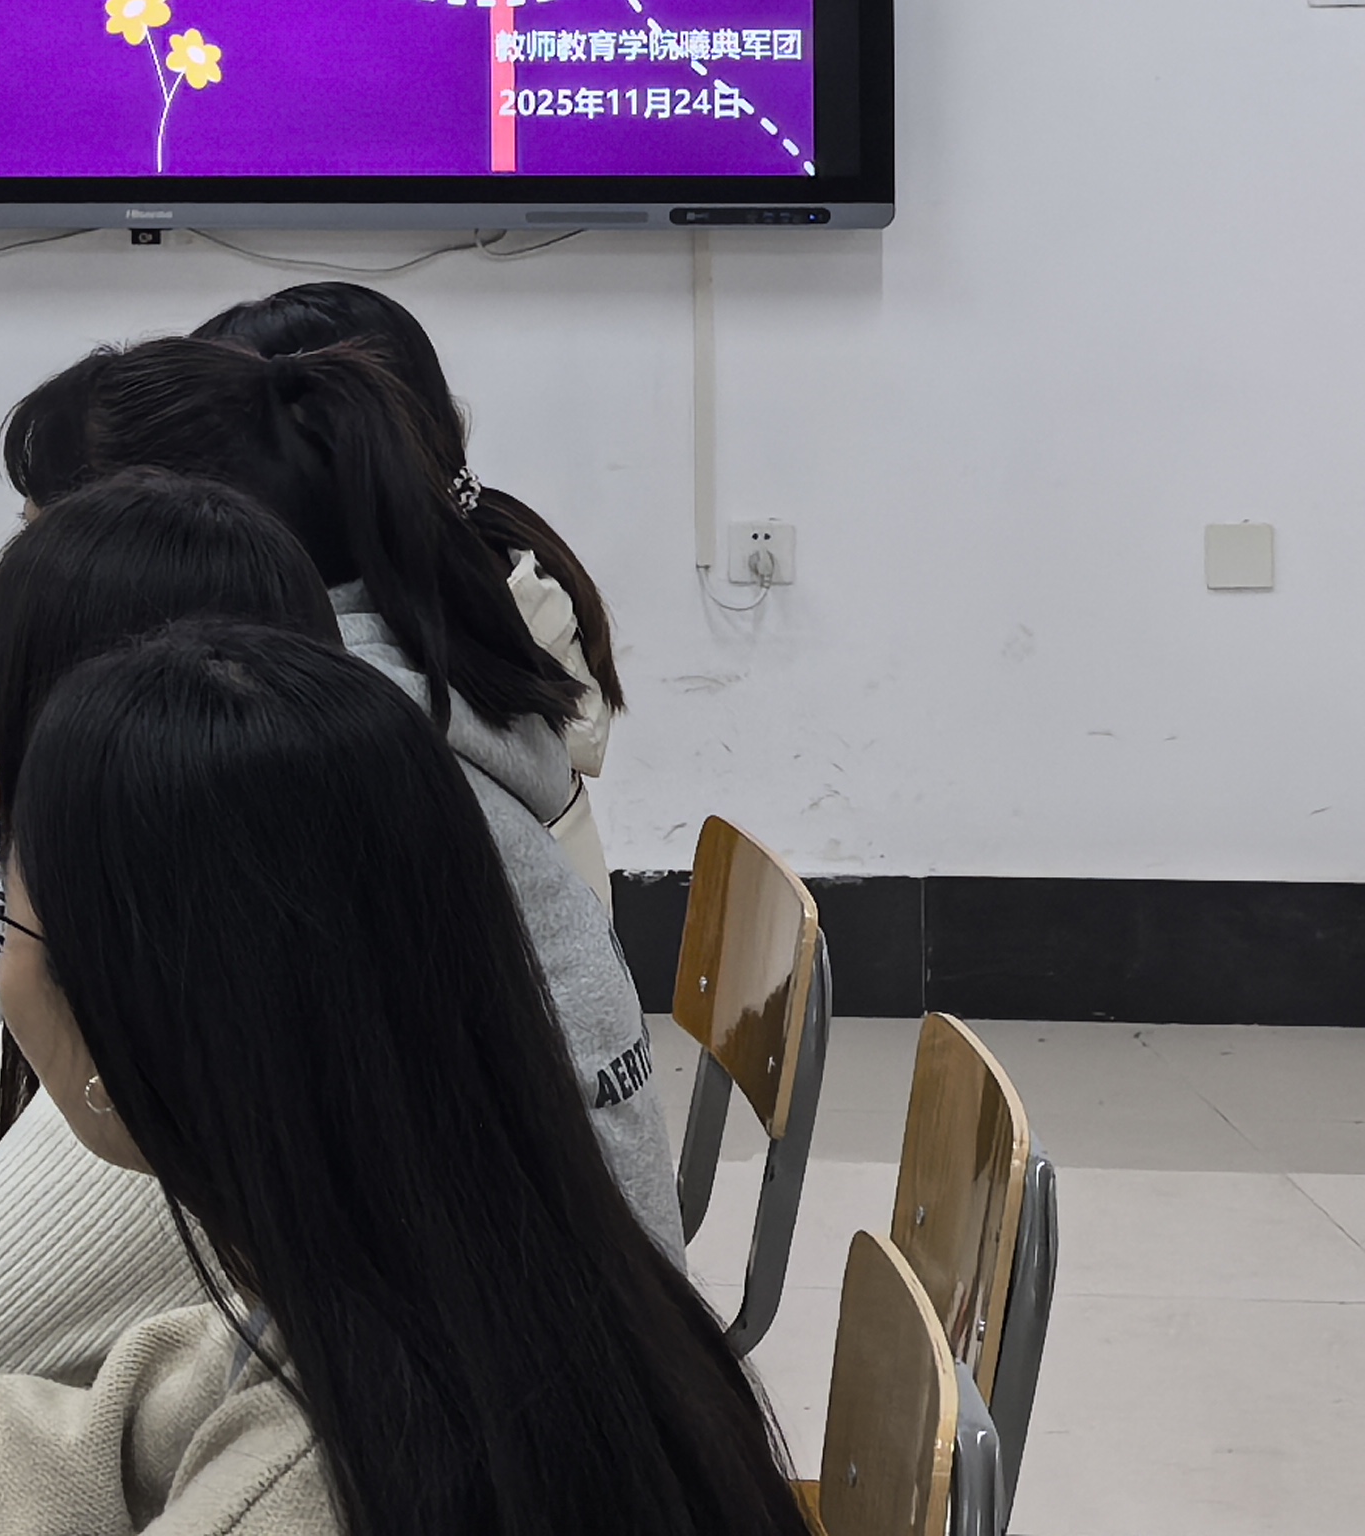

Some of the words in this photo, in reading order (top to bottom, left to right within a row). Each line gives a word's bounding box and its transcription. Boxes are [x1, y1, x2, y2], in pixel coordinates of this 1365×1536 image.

[494, 28, 803, 63] 教师教育学院曦典军团
[498, 87, 741, 119] 2025年11月24日
